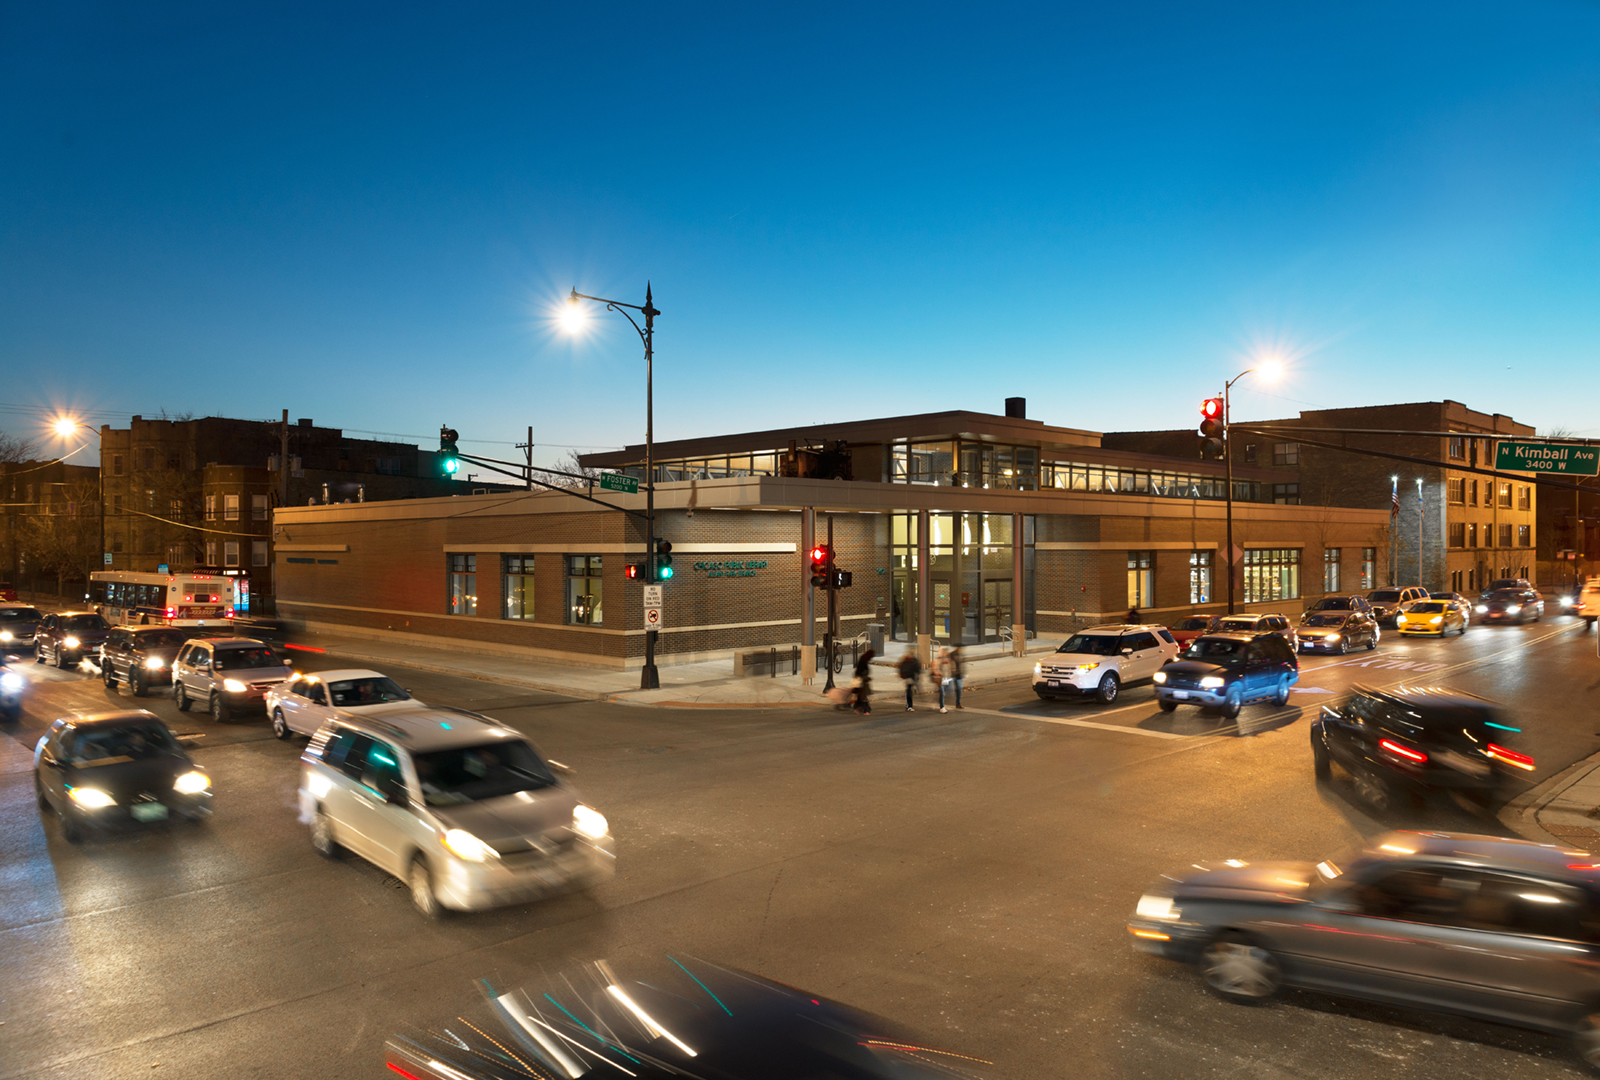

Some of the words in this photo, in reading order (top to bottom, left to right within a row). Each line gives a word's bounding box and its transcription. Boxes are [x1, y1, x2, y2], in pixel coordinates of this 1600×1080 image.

[1502, 447, 1509, 455] N
[1515, 445, 1569, 460] Kimball
[1574, 450, 1594, 460] Ave
[1525, 460, 1553, 470] 3400
[1558, 461, 1567, 470] W
[607, 475, 631, 485] FOSTER
[693, 561, 723, 570] CHICAGO
[724, 561, 745, 569] PUBLIC
[746, 561, 768, 569] LIBRARY
